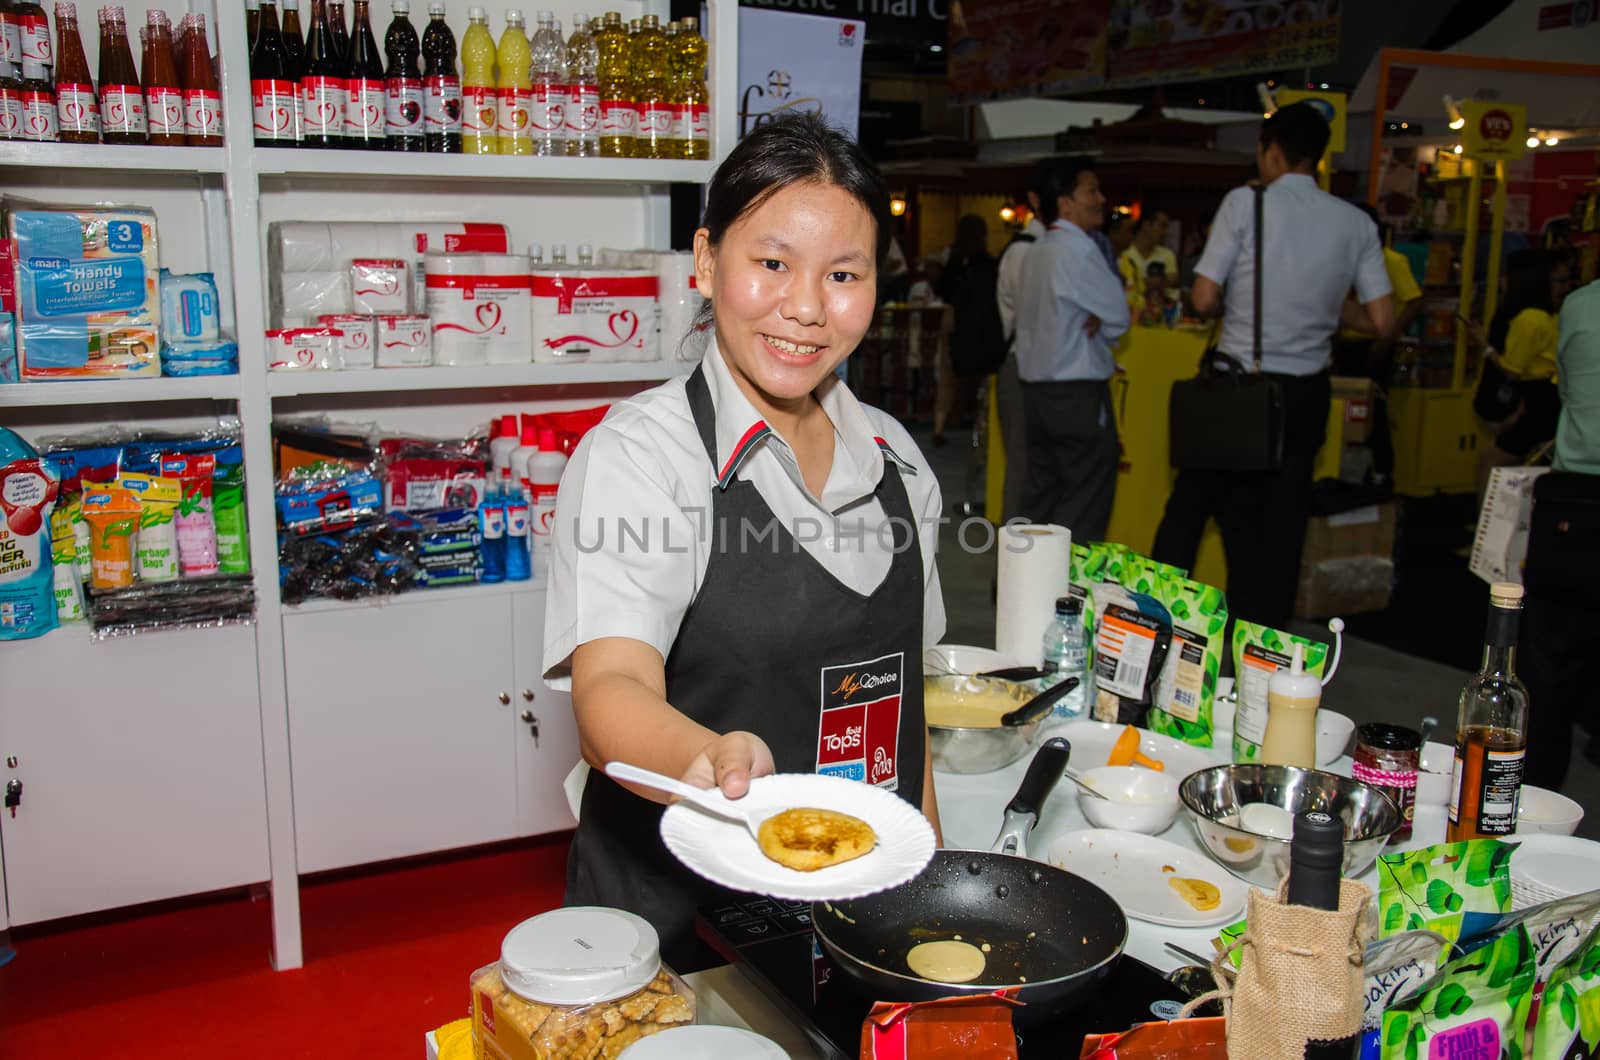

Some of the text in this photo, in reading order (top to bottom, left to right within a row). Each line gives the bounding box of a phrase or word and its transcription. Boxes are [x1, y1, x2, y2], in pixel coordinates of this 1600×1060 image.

[117, 224, 132, 241] 3
[35, 259, 60, 269] mart
[74, 264, 123, 281] Handy
[63, 279, 117, 294] Towels
[832, 672, 861, 700] My
[823, 733, 861, 755] Tops
[1437, 1024, 1495, 1057] Fruit &
